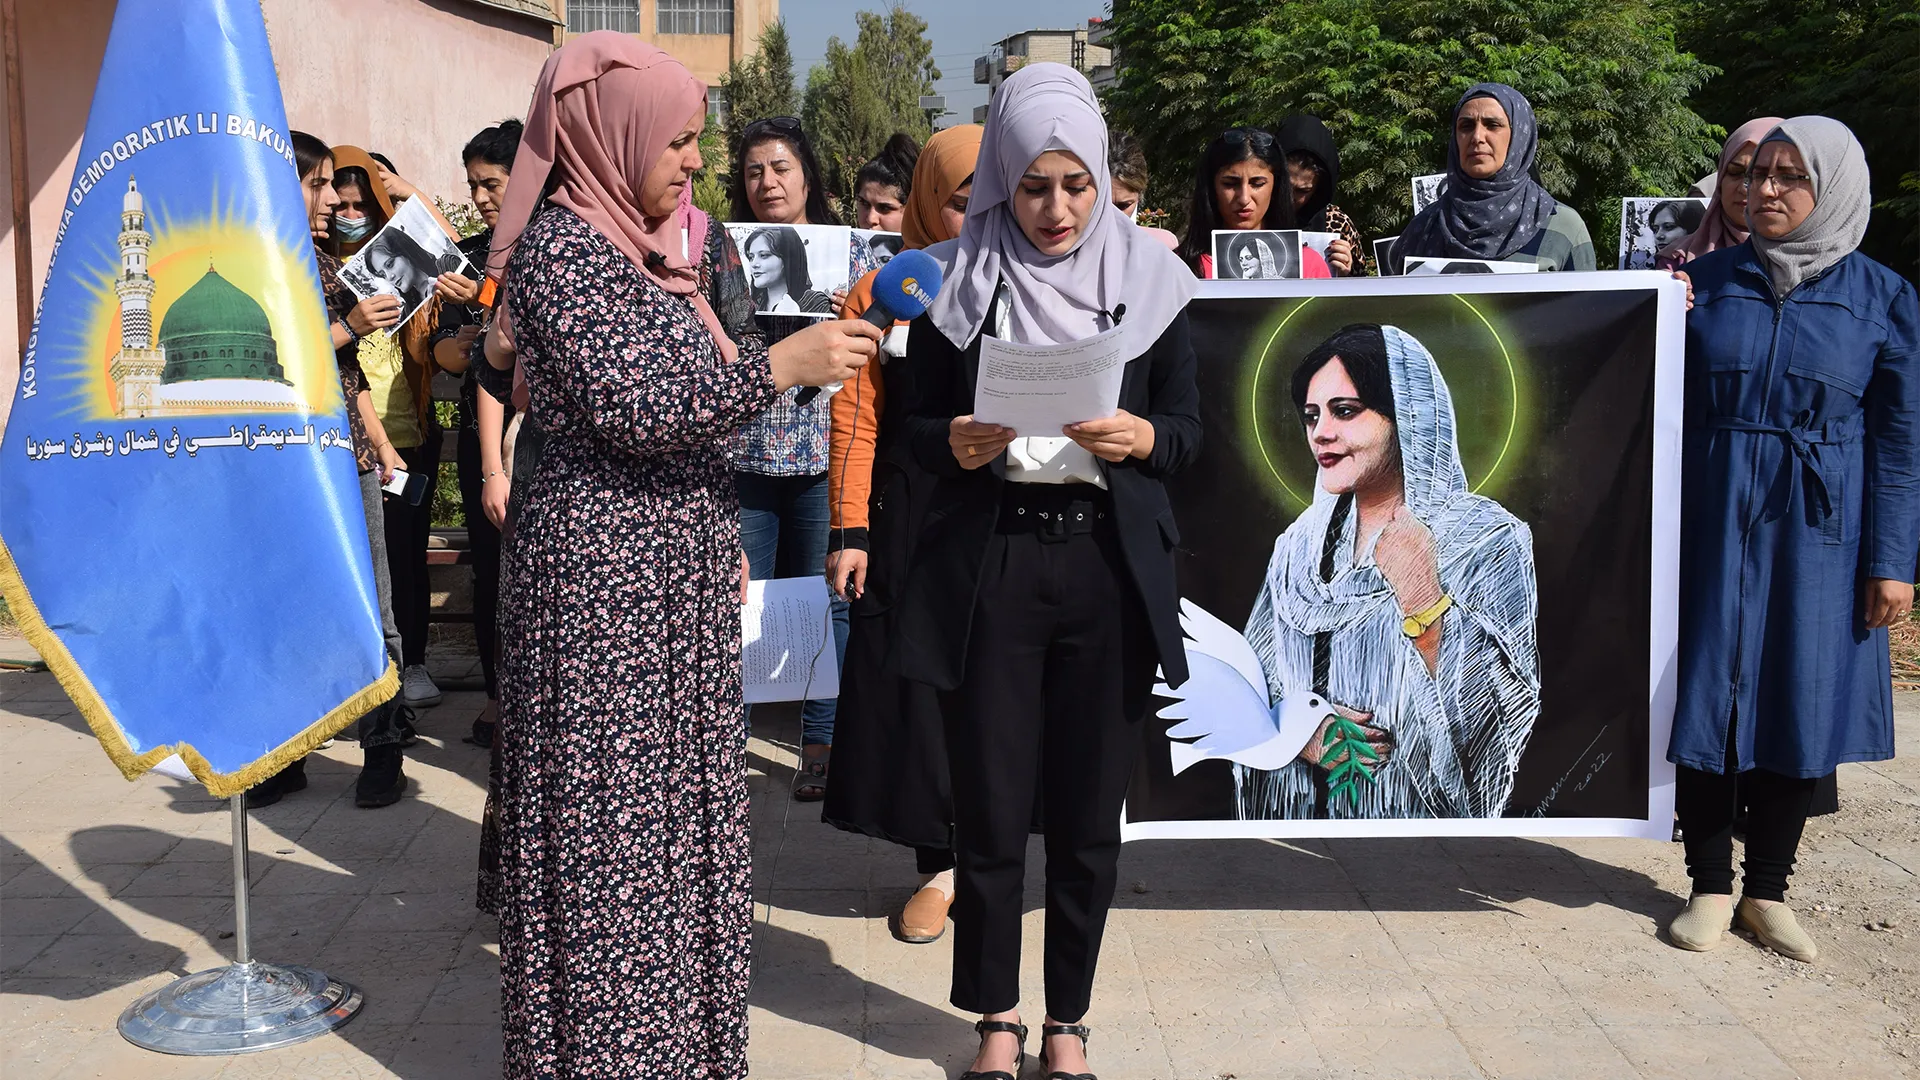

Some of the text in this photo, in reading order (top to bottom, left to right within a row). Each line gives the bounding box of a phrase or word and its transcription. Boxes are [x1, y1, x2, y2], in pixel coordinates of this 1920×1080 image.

[70, 113, 191, 207] DEMOQRATIK
[196, 112, 218, 134] LI
[225, 113, 295, 167] BAKUR
[25, 435, 66, 461] سوريا
[69, 430, 115, 459] وشرق
[118, 428, 159, 456] شمال
[163, 426, 181, 458] في
[184, 423, 316, 458] الديمقراطي
[1573, 752, 1612, 791] 2022
